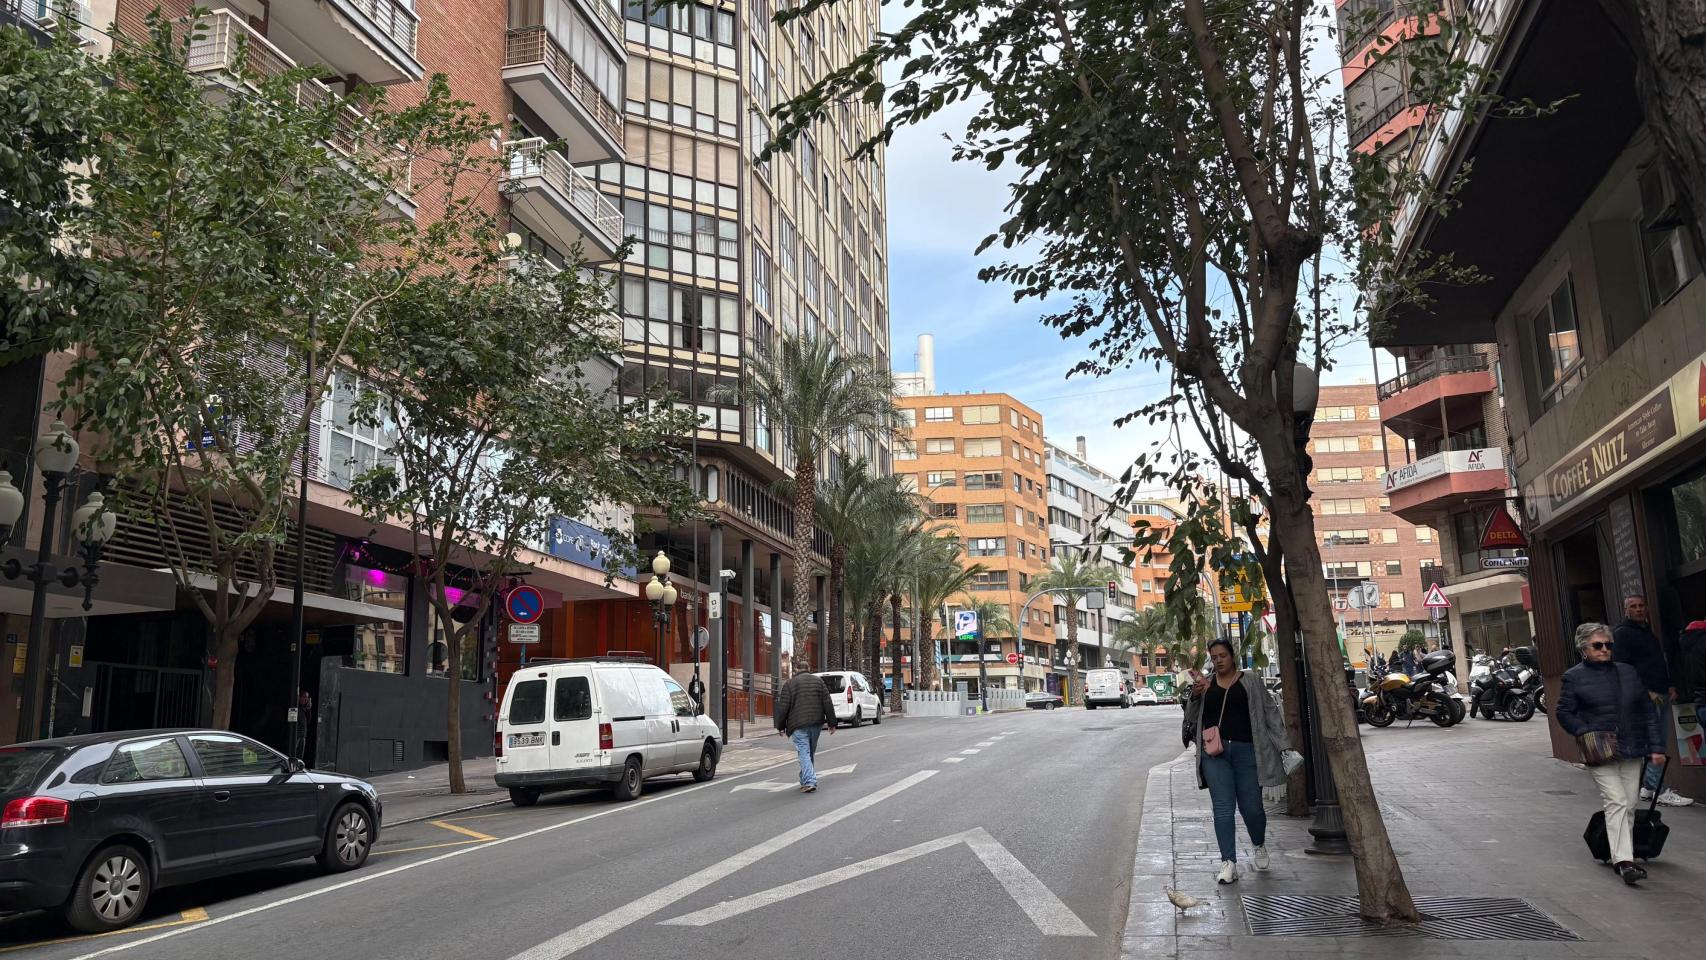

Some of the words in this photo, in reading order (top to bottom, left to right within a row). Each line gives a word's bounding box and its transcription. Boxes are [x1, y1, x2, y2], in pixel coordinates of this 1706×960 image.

[1399, 464, 1418, 481] AFIDA
[1553, 458, 1591, 502] COFFEE
[1591, 431, 1628, 479] NUTZ
[1490, 531, 1517, 539] DELTA
